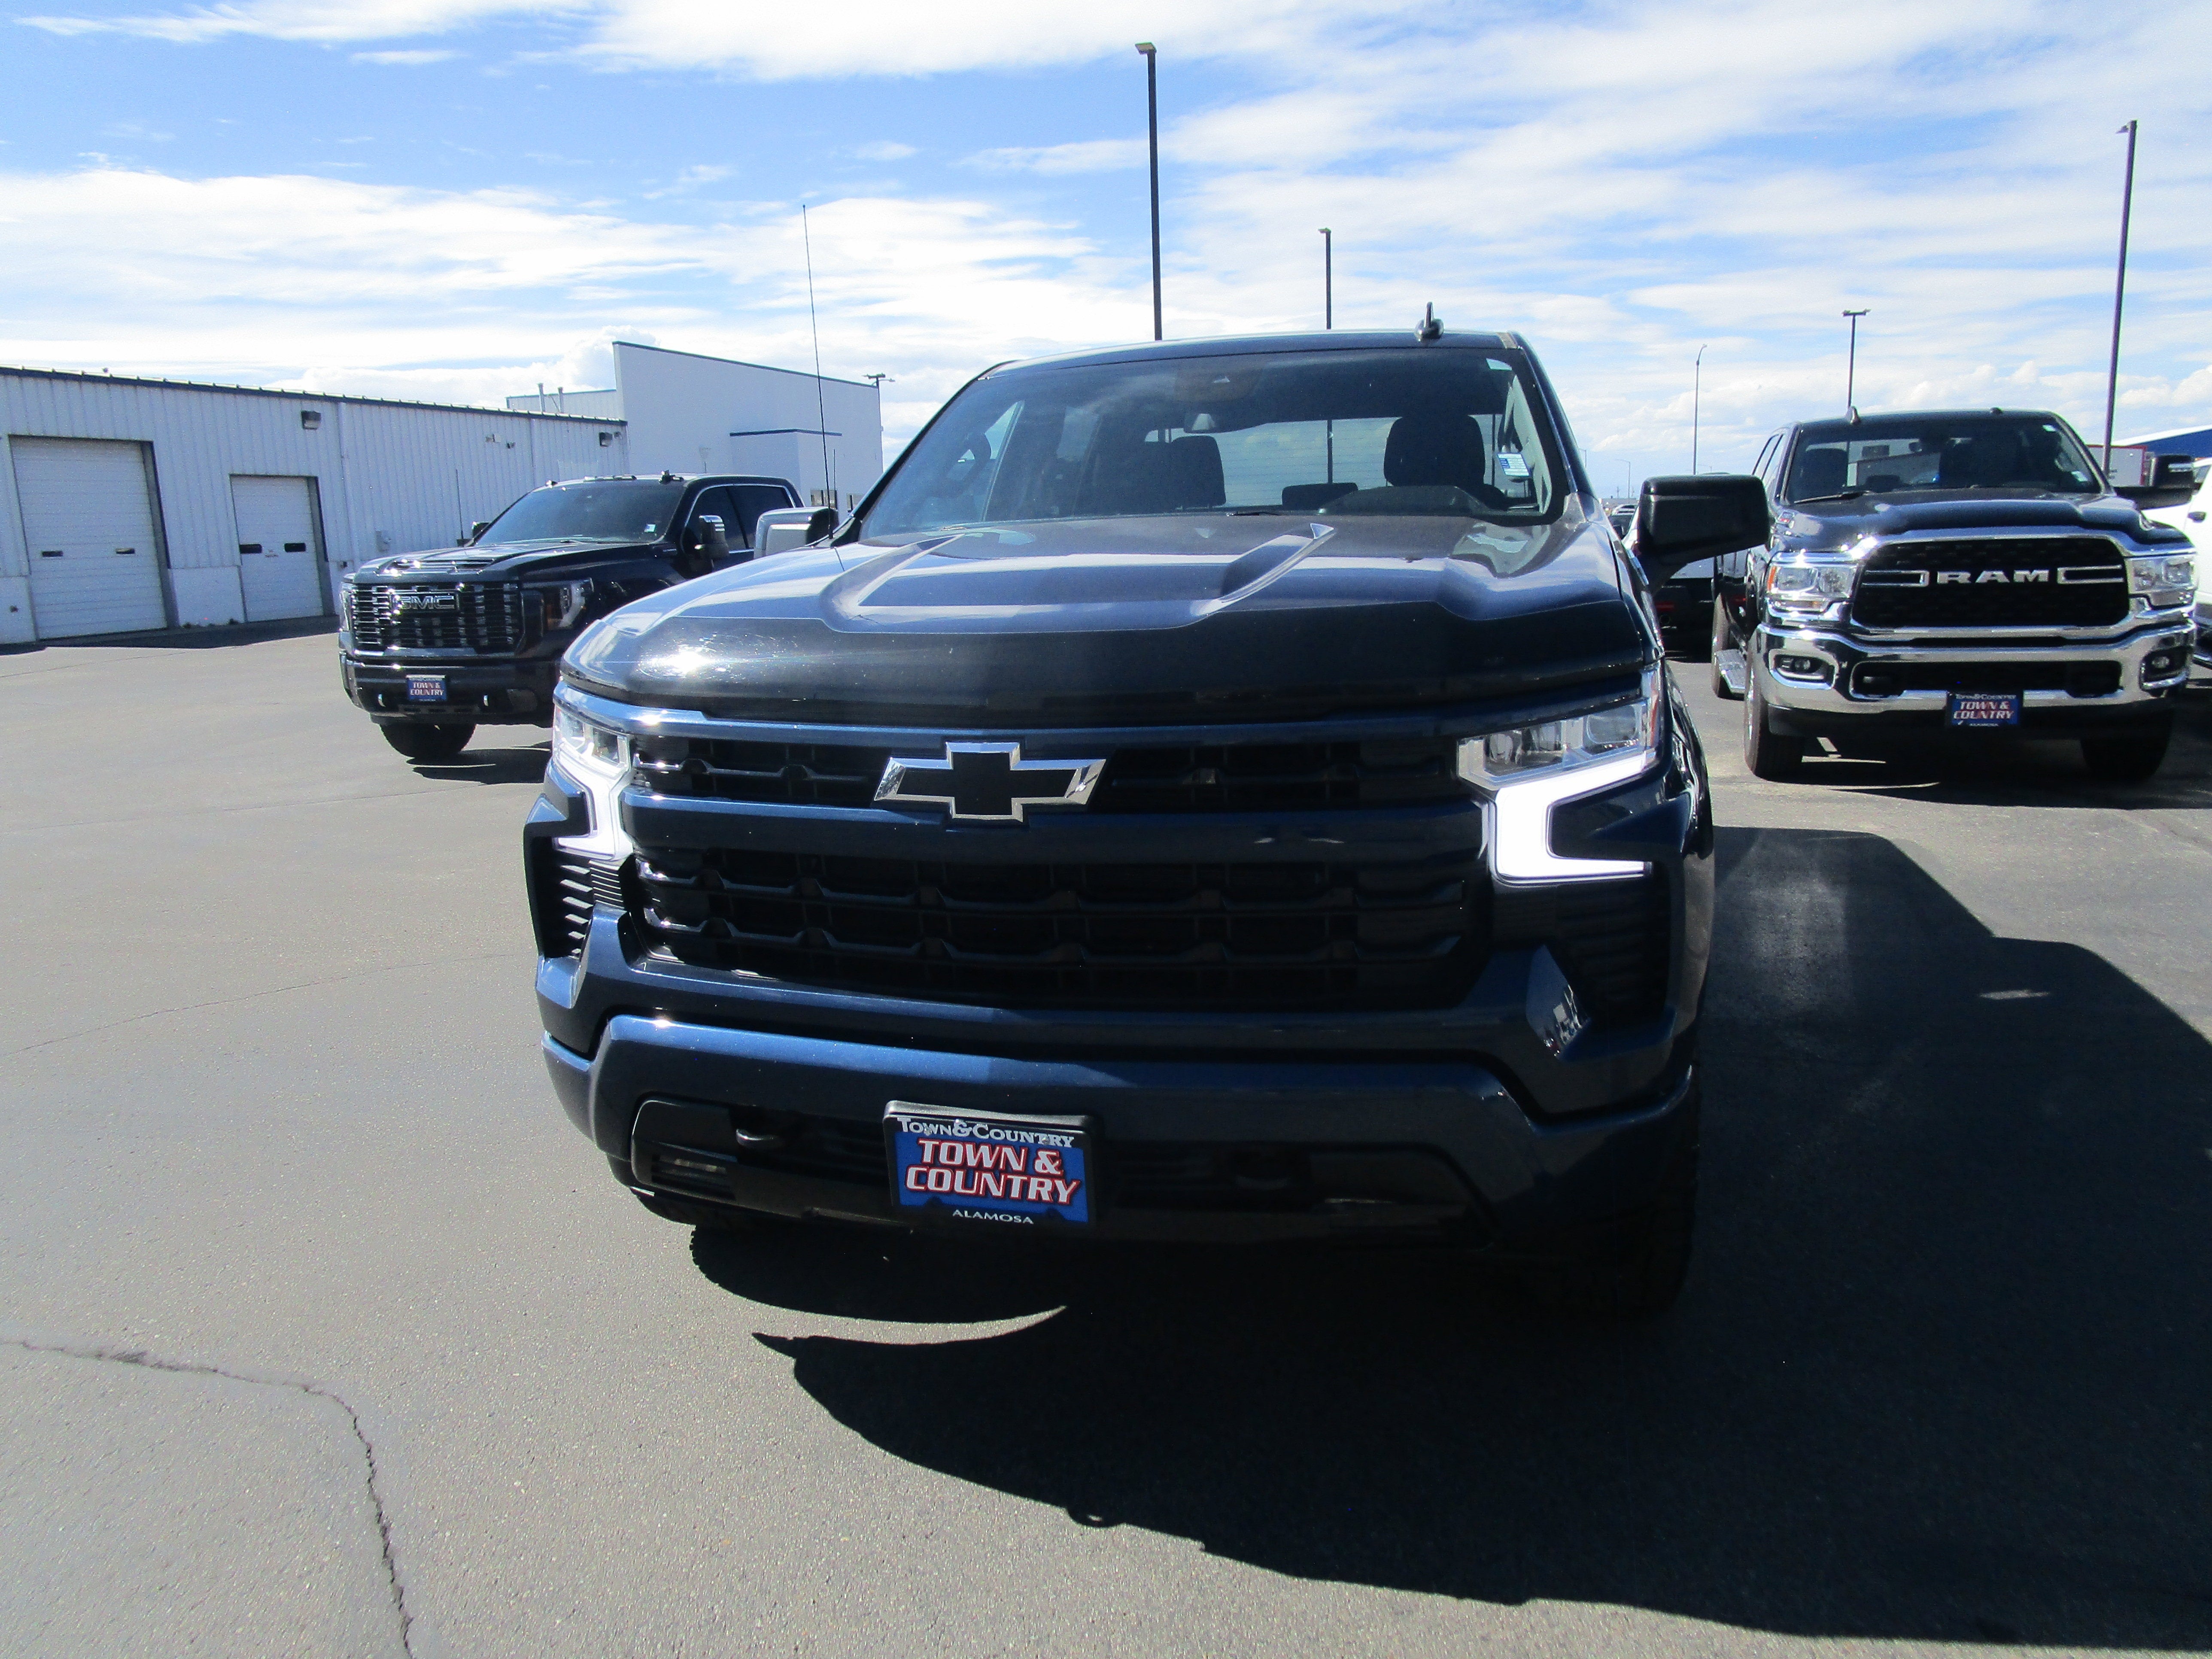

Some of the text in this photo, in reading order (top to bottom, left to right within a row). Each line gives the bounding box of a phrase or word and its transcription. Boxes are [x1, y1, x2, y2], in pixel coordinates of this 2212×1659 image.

[1937, 569, 2049, 584] RAM
[392, 595, 455, 609] GMC
[1960, 701, 1997, 710] TOWN
[1954, 711, 2014, 719] COUNTRY
[918, 1138, 1064, 1176] TOWN &
[905, 1165, 1081, 1205] COUNTRY
[952, 1209, 1034, 1224] ALAMOSA
